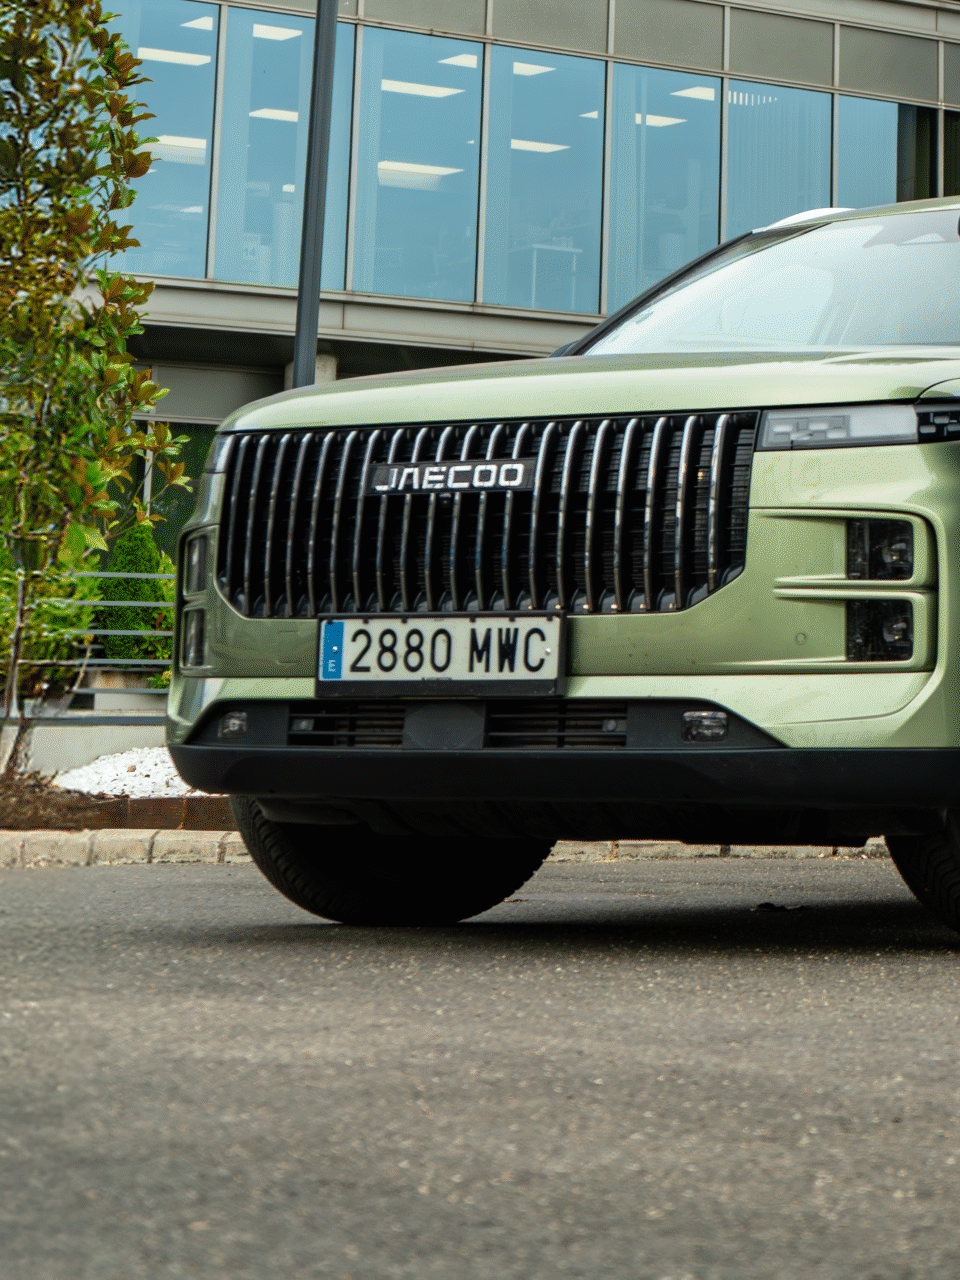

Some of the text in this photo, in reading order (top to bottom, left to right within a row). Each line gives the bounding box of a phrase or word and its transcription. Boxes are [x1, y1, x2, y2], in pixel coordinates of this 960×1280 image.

[374, 463, 524, 491] JAECOO
[350, 627, 546, 673] 2880 MWC
[327, 659, 337, 673] E
